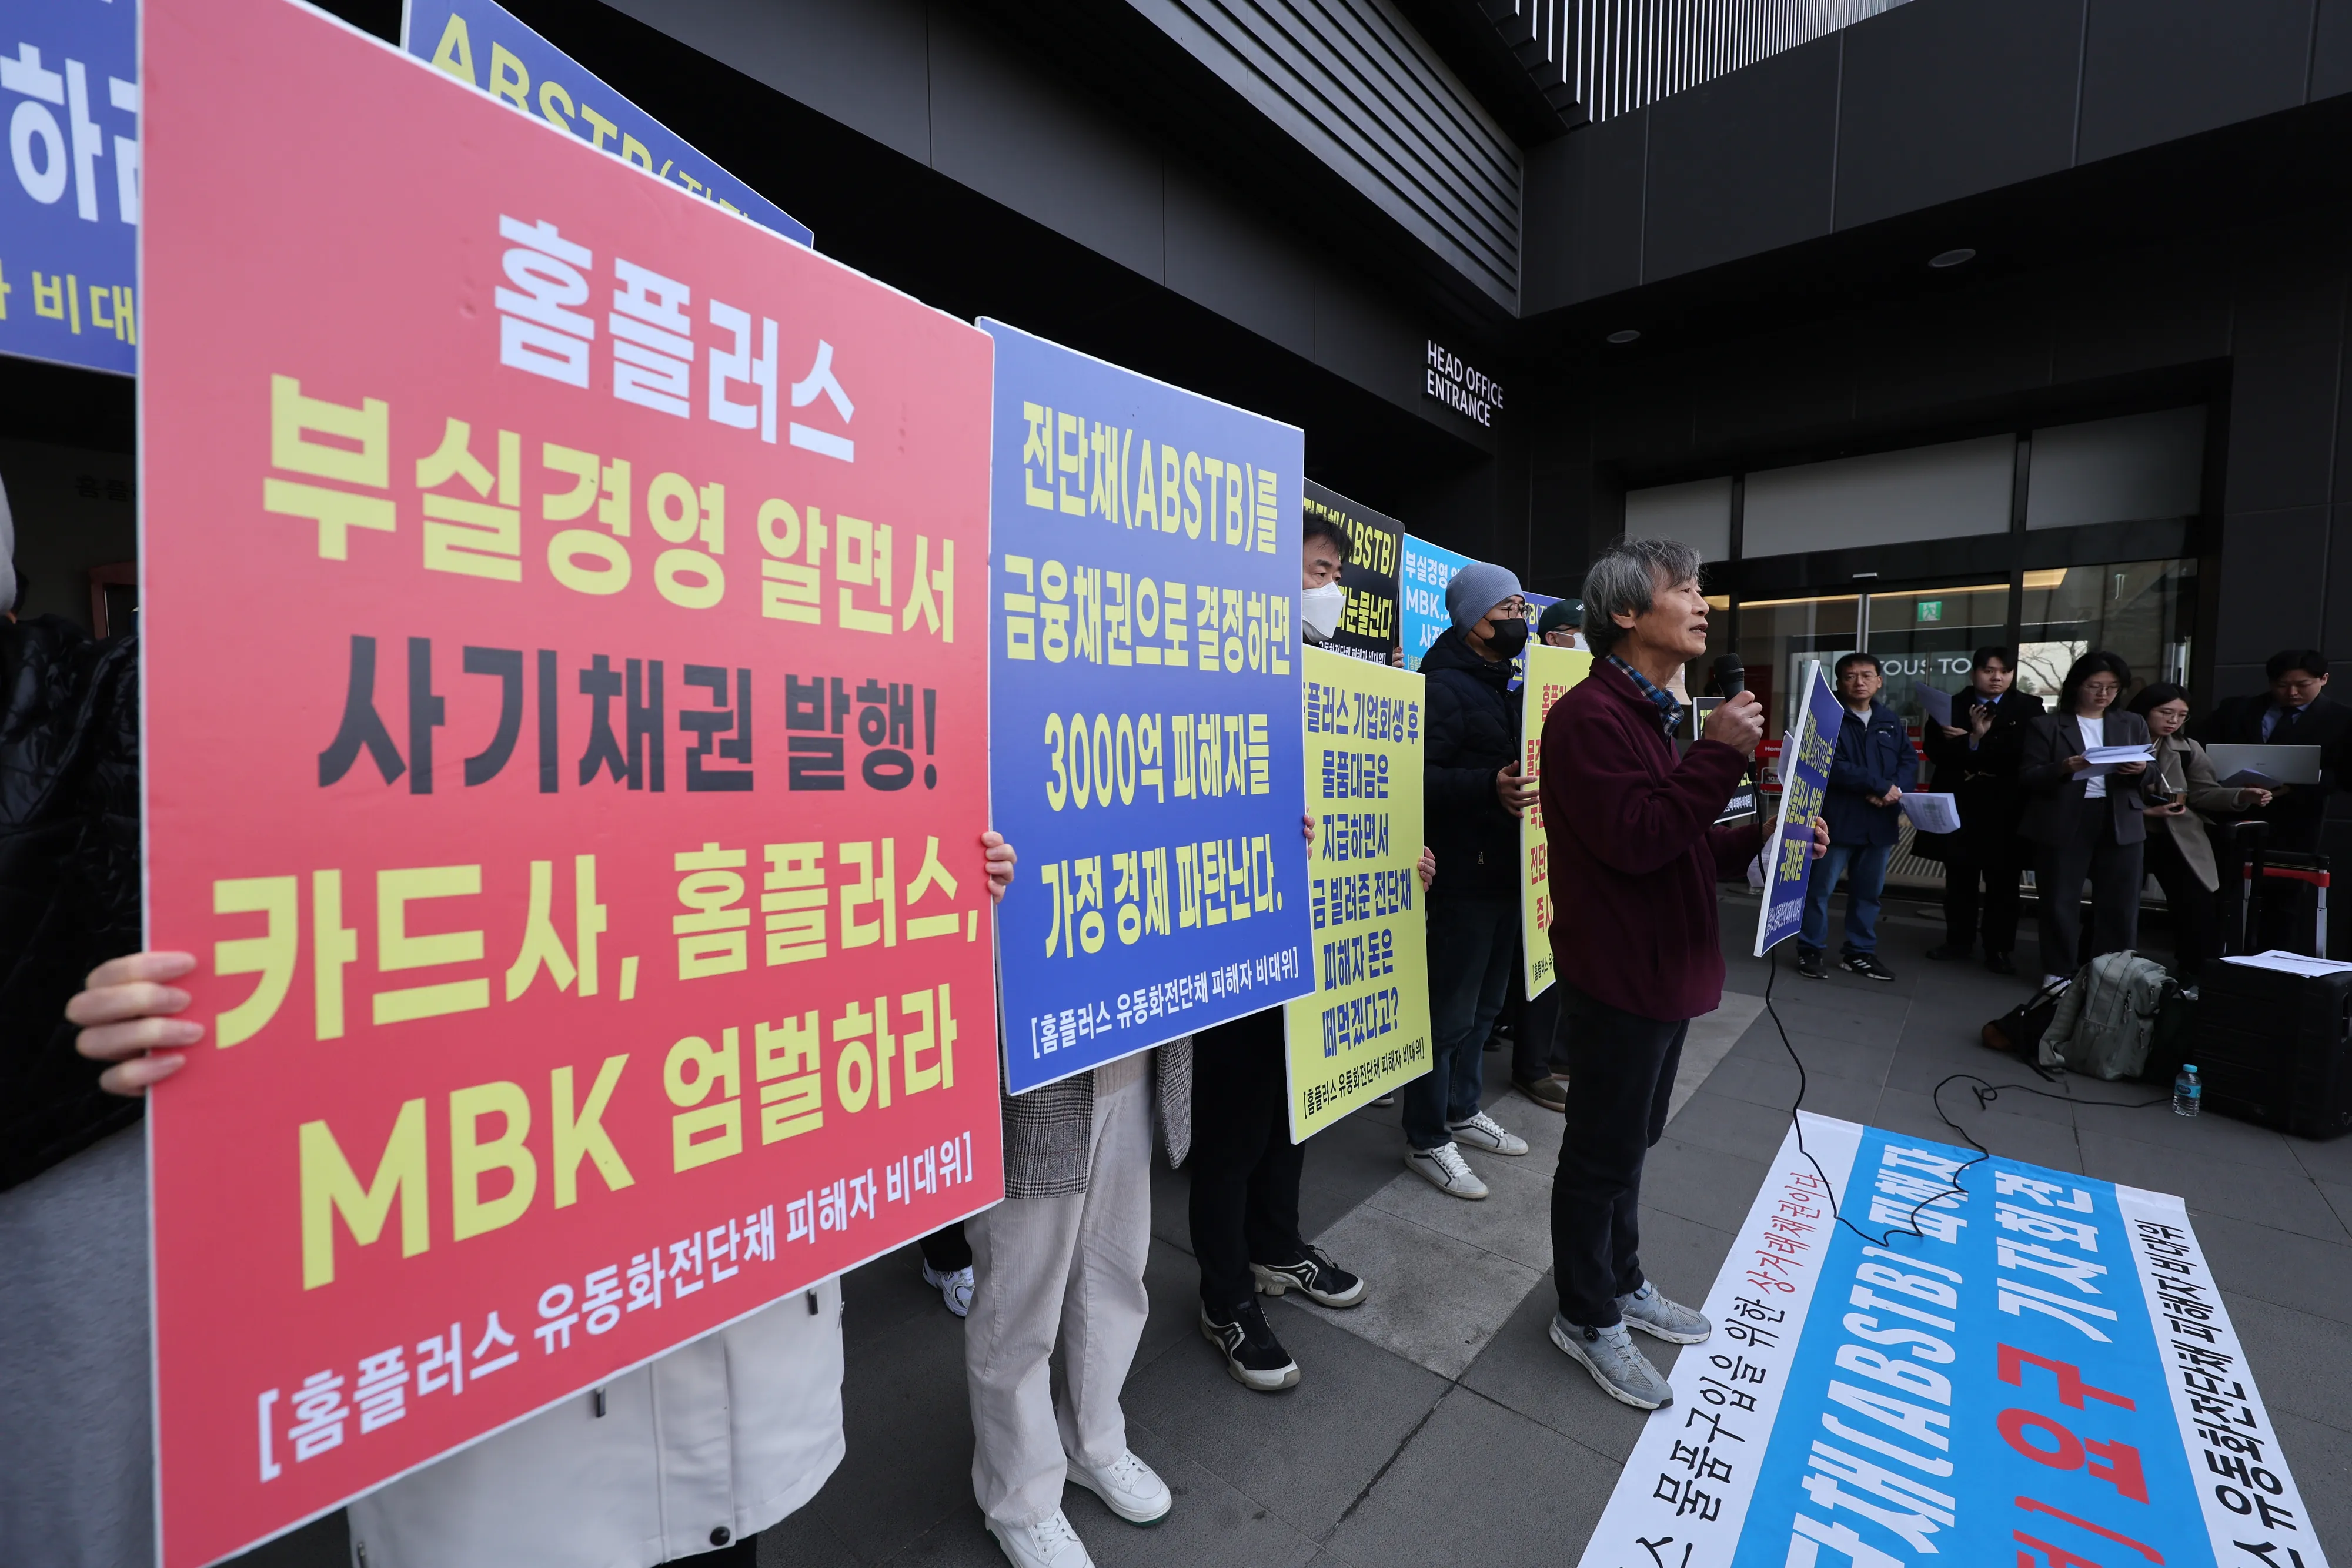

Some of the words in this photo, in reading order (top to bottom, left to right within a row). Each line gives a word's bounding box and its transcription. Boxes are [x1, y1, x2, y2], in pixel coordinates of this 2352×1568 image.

[495, 214, 855, 463] 홈플러스
[1428, 339, 1463, 382] HEAD
[1466, 366, 1504, 409] OFFICE
[1427, 369, 1491, 427] ENTRANCE
[263, 373, 725, 609] 부실경영
[757, 498, 954, 643] 알면서
[1023, 401, 1277, 554] 전단채(ABSTB)를
[1004, 554, 1189, 667] 금융채권으로
[1197, 584, 1291, 675] 결정하면
[1405, 550, 1448, 589] 부실경영
[318, 634, 754, 795] 사기채권
[784, 673, 937, 791] 발행!
[1044, 712, 1164, 811] 3000억
[1172, 713, 1269, 800] 피해자들
[1303, 681, 1349, 736] 플러스
[1354, 692, 1404, 744] 기업회생
[1408, 701, 1419, 745] 후
[1322, 750, 1389, 798] 물품대금은
[1322, 813, 1389, 862] 지급하면서
[213, 854, 639, 1049] 카드사,
[673, 835, 978, 981] 홈플러스,
[1041, 855, 1105, 958] 가정
[1112, 850, 1171, 945] 경제
[1176, 834, 1282, 929] 파탄난다.
[1331, 873, 1371, 926] 빌려준
[1374, 868, 1412, 917] 전단채
[1031, 1000, 1112, 1059] [홈플러스
[1117, 971, 1208, 1029] 유동화전단채
[1211, 959, 1252, 998] 피해자
[1256, 946, 1298, 986] 비대위]
[1323, 934, 1365, 991] 피해자
[1368, 928, 1394, 979] 돈은
[1322, 986, 1399, 1058] 떼먹겠다고?
[1303, 1079, 1337, 1119] [홈플러스
[1339, 1057, 1381, 1098] 유동화전단채
[1382, 1047, 1401, 1075] 피해자
[1402, 1037, 1425, 1065] 비대위]
[299, 1053, 636, 1292] MBK
[663, 983, 957, 1174] 엄벌하라
[1746, 1172, 1833, 1295] 상거래채권이다
[1868, 1144, 1970, 1245] 피해자
[2134, 1219, 2198, 1276] 비대위
[258, 1310, 519, 1483] [홈플러스
[534, 1205, 775, 1355] 유동화전단채
[786, 1168, 877, 1245] 피해자
[886, 1131, 973, 1205] 비대위]
[1995, 1170, 2118, 1343] 기자회견
[2151, 1272, 2223, 1345] 피해자
[1725, 1296, 1785, 1348] 위한
[1653, 1355, 1766, 1522] 물품구입을
[1996, 1342, 2150, 1505] 요구
[2170, 1339, 2297, 1531] 유동화전단채
